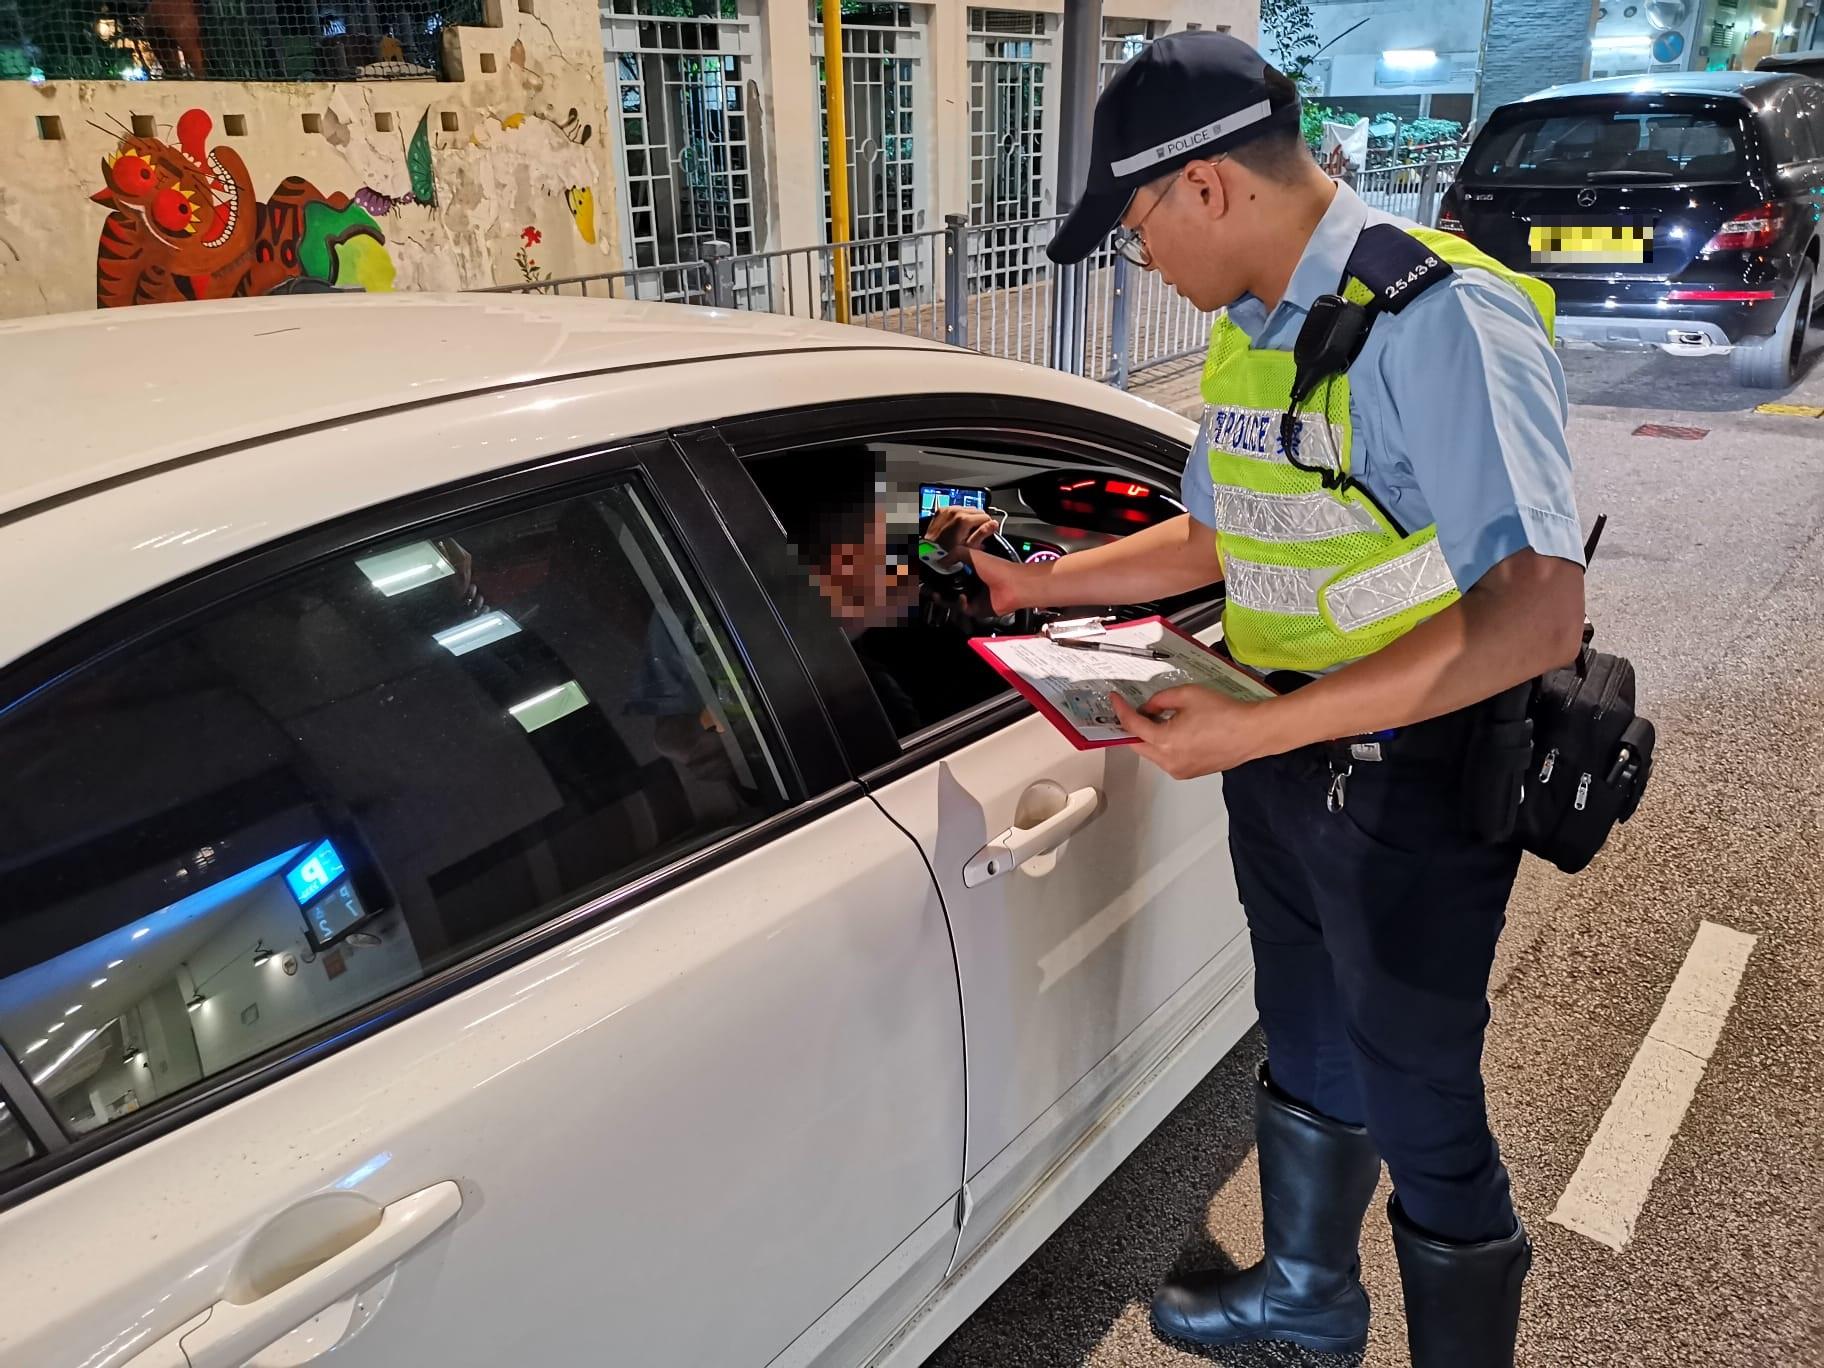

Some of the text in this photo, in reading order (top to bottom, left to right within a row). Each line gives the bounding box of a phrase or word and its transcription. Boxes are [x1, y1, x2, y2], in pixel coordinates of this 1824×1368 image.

[1167, 130, 1210, 153] POLICE
[1385, 256, 1438, 299] 25438
[1224, 411, 1270, 452] POLICE
